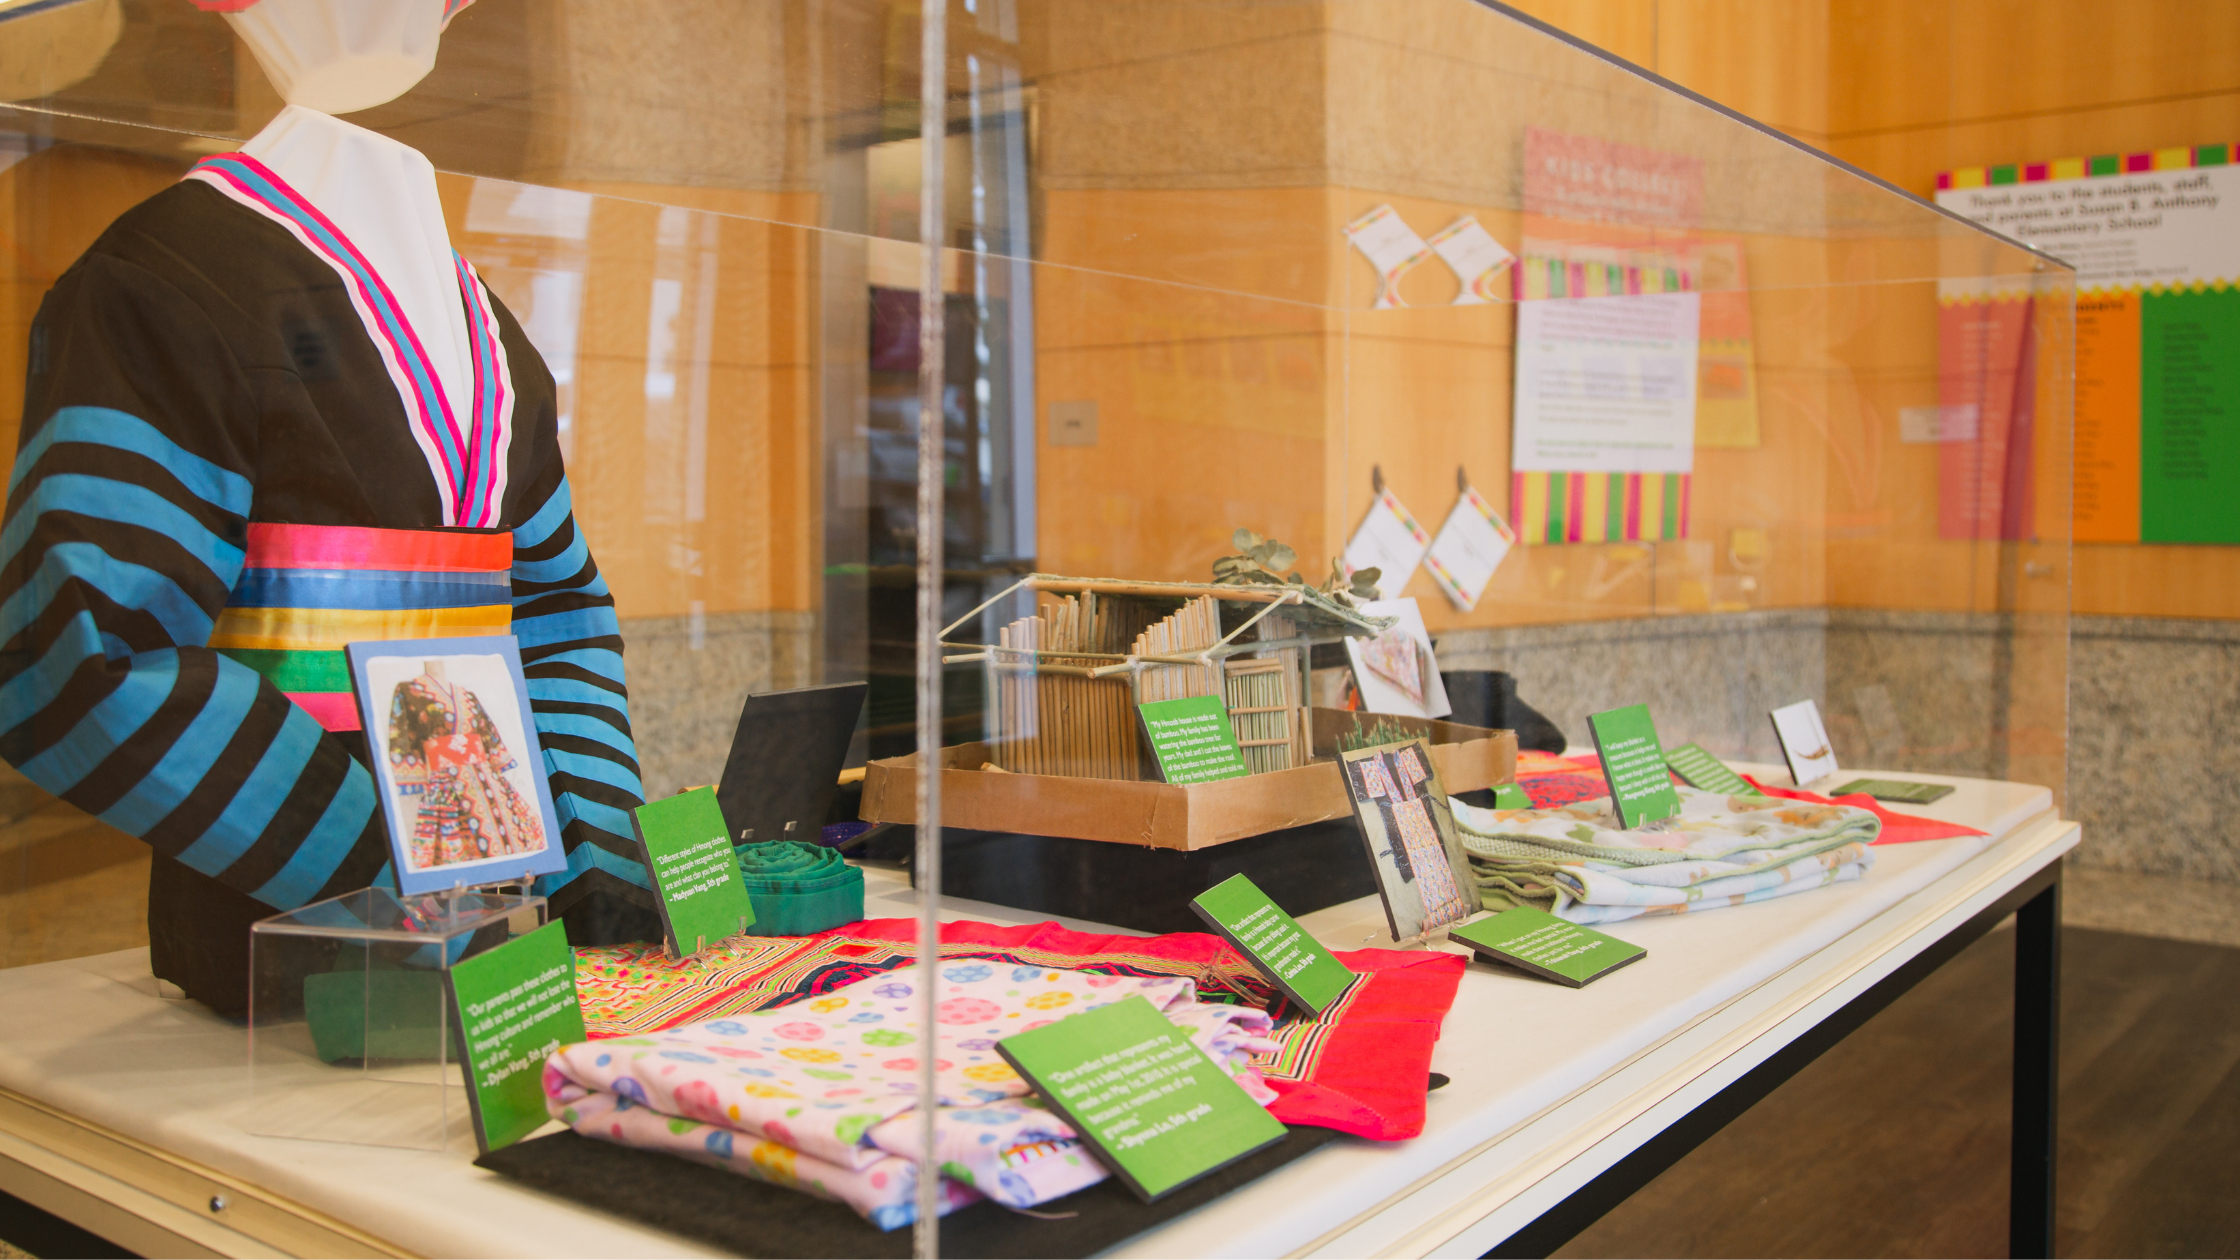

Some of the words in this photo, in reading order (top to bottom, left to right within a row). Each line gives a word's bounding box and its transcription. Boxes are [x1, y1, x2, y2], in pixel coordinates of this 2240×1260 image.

[1971, 192, 2012, 208] Thank
[2018, 194, 2044, 208] you
[2049, 189, 2066, 202] to
[2071, 187, 2094, 199] the
[1998, 209, 2053, 224] parents
[2078, 203, 2124, 217] Susan
[2150, 194, 2220, 211] Anthony
[2017, 221, 2101, 238] Elementary
[2108, 214, 2163, 230] School
[1180, 728, 1188, 737] My
[1181, 761, 1200, 769] bamboo
[1205, 768, 1220, 776] helped
[679, 848, 692, 858] styles
[692, 844, 696, 853] of
[696, 842, 712, 851] Hmong
[669, 866, 680, 874] help
[680, 860, 694, 873] people
[694, 854, 714, 865] recognize
[723, 848, 731, 857] you
[673, 878, 682, 888] and
[682, 875, 693, 884] what
[702, 869, 710, 878] you
[709, 864, 724, 873] belong
[707, 879, 716, 888] 5th
[716, 874, 729, 886] grade
[560, 964, 567, 973] to
[560, 980, 570, 990] the
[521, 1015, 534, 1030] and
[562, 996, 575, 1006] who
[1102, 1054, 1121, 1065] that
[1120, 1040, 1160, 1058] represents
[1157, 1035, 1172, 1044] my
[1061, 1083, 1090, 1098] family
[1101, 1070, 1123, 1082] baby
[1088, 1106, 1124, 1124] because
[1160, 1084, 1175, 1094] me
[1172, 1078, 1184, 1089] of
[1182, 1076, 1196, 1085] my
[1186, 1104, 1212, 1122] grade
